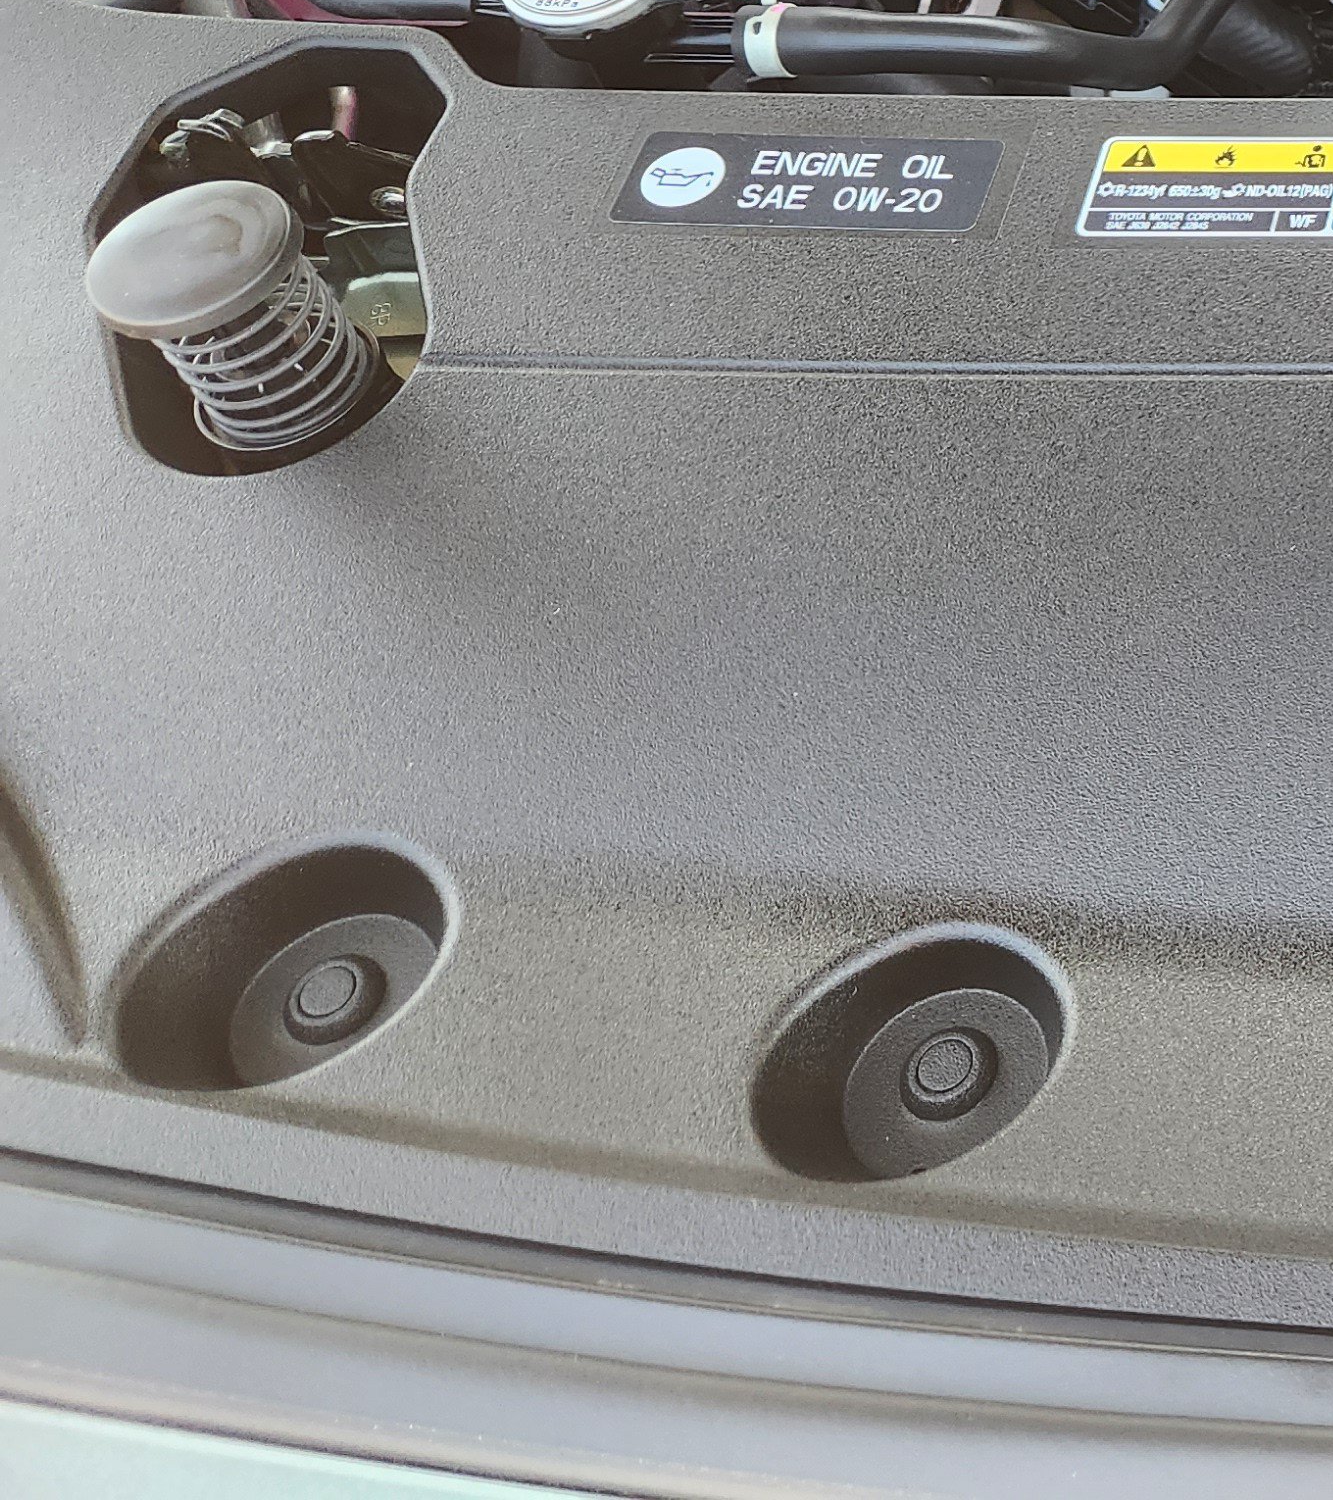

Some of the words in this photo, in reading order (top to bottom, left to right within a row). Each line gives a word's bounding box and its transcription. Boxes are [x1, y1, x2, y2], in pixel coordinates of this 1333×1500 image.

[750, 150, 883, 178] ENGINE
[902, 154, 954, 180] OIL
[737, 184, 815, 210] SAE
[833, 187, 943, 213] 0W-20
[1115, 184, 1167, 200] R-1234yf
[1246, 183, 1333, 199] ND-OIL12(PAG)
[1107, 212, 1146, 221] TOYOTA
[1149, 212, 1183, 221] MOTOR
[1185, 212, 1254, 222] CORPORATION
[1289, 214, 1318, 229] WF
[1104, 221, 1125, 230] SAE
